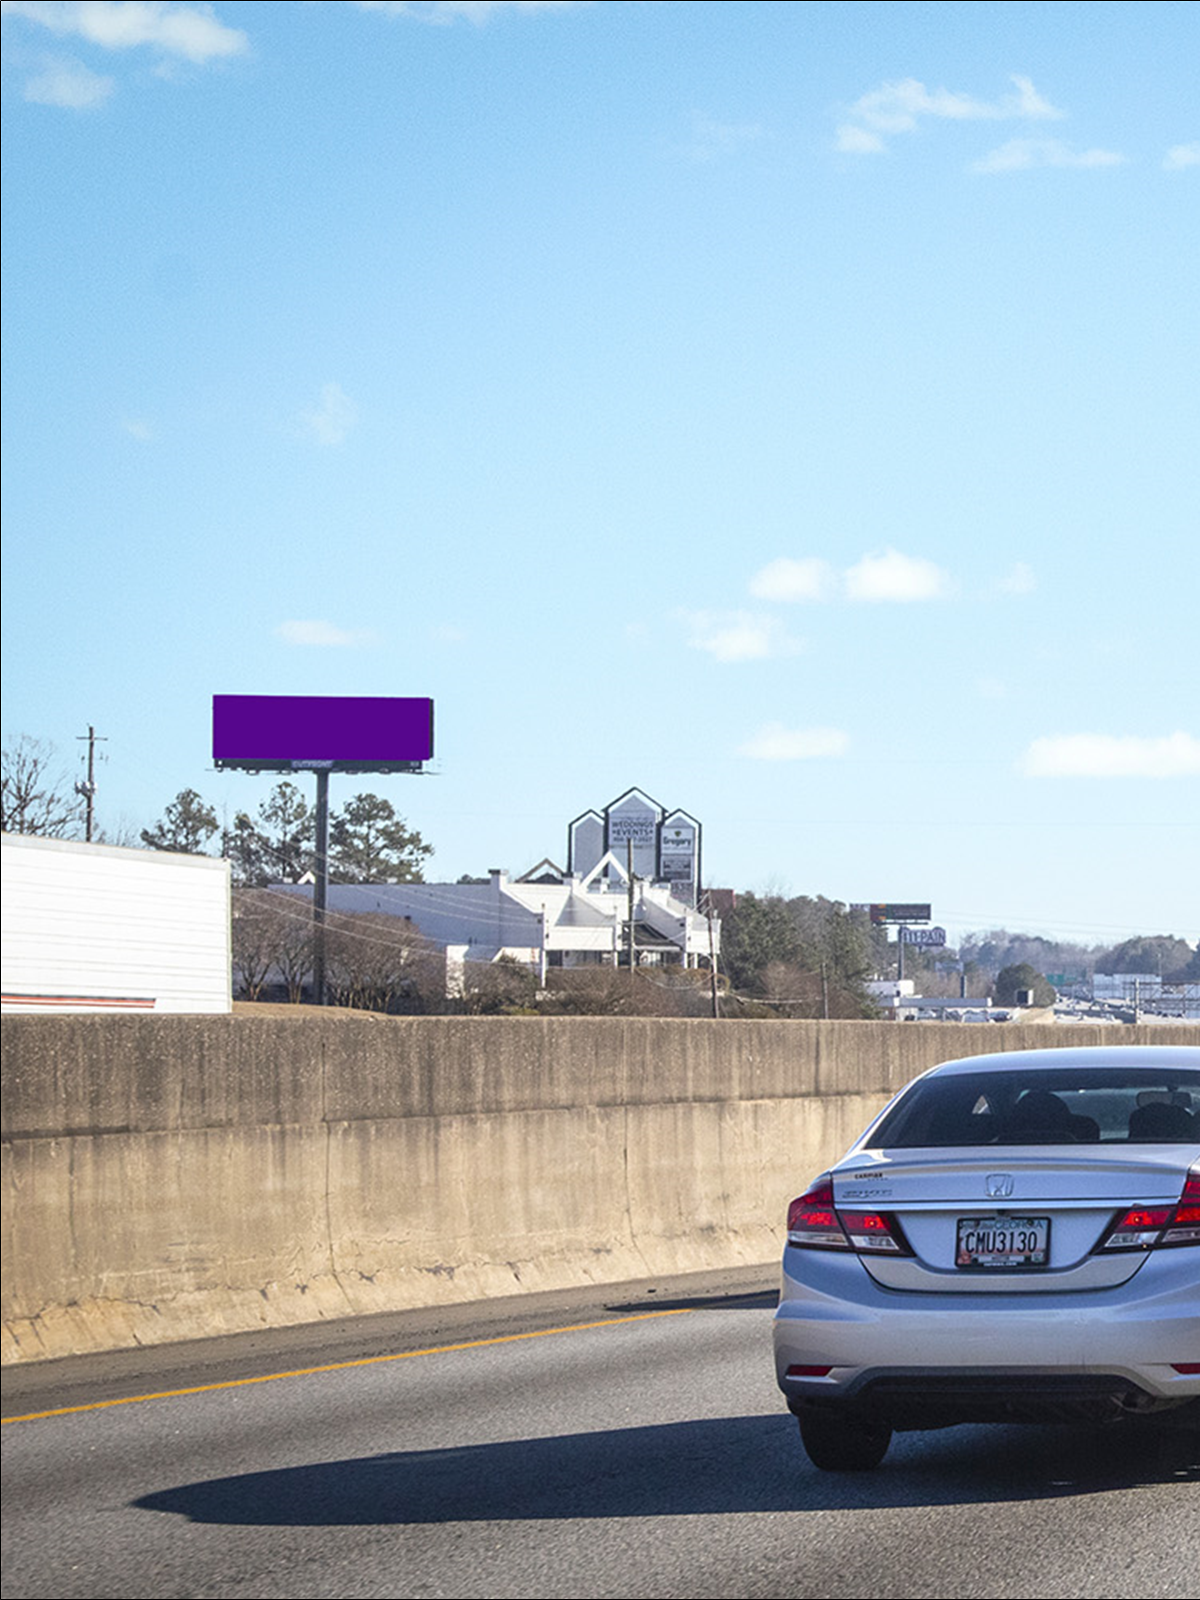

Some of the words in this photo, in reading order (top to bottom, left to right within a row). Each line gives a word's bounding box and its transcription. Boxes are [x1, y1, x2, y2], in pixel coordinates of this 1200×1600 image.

[612, 820, 654, 828] WEDDINGS
[616, 828, 649, 836] EVENTS
[662, 836, 692, 847] Gregory
[965, 1231, 1038, 1254] CMU3130
